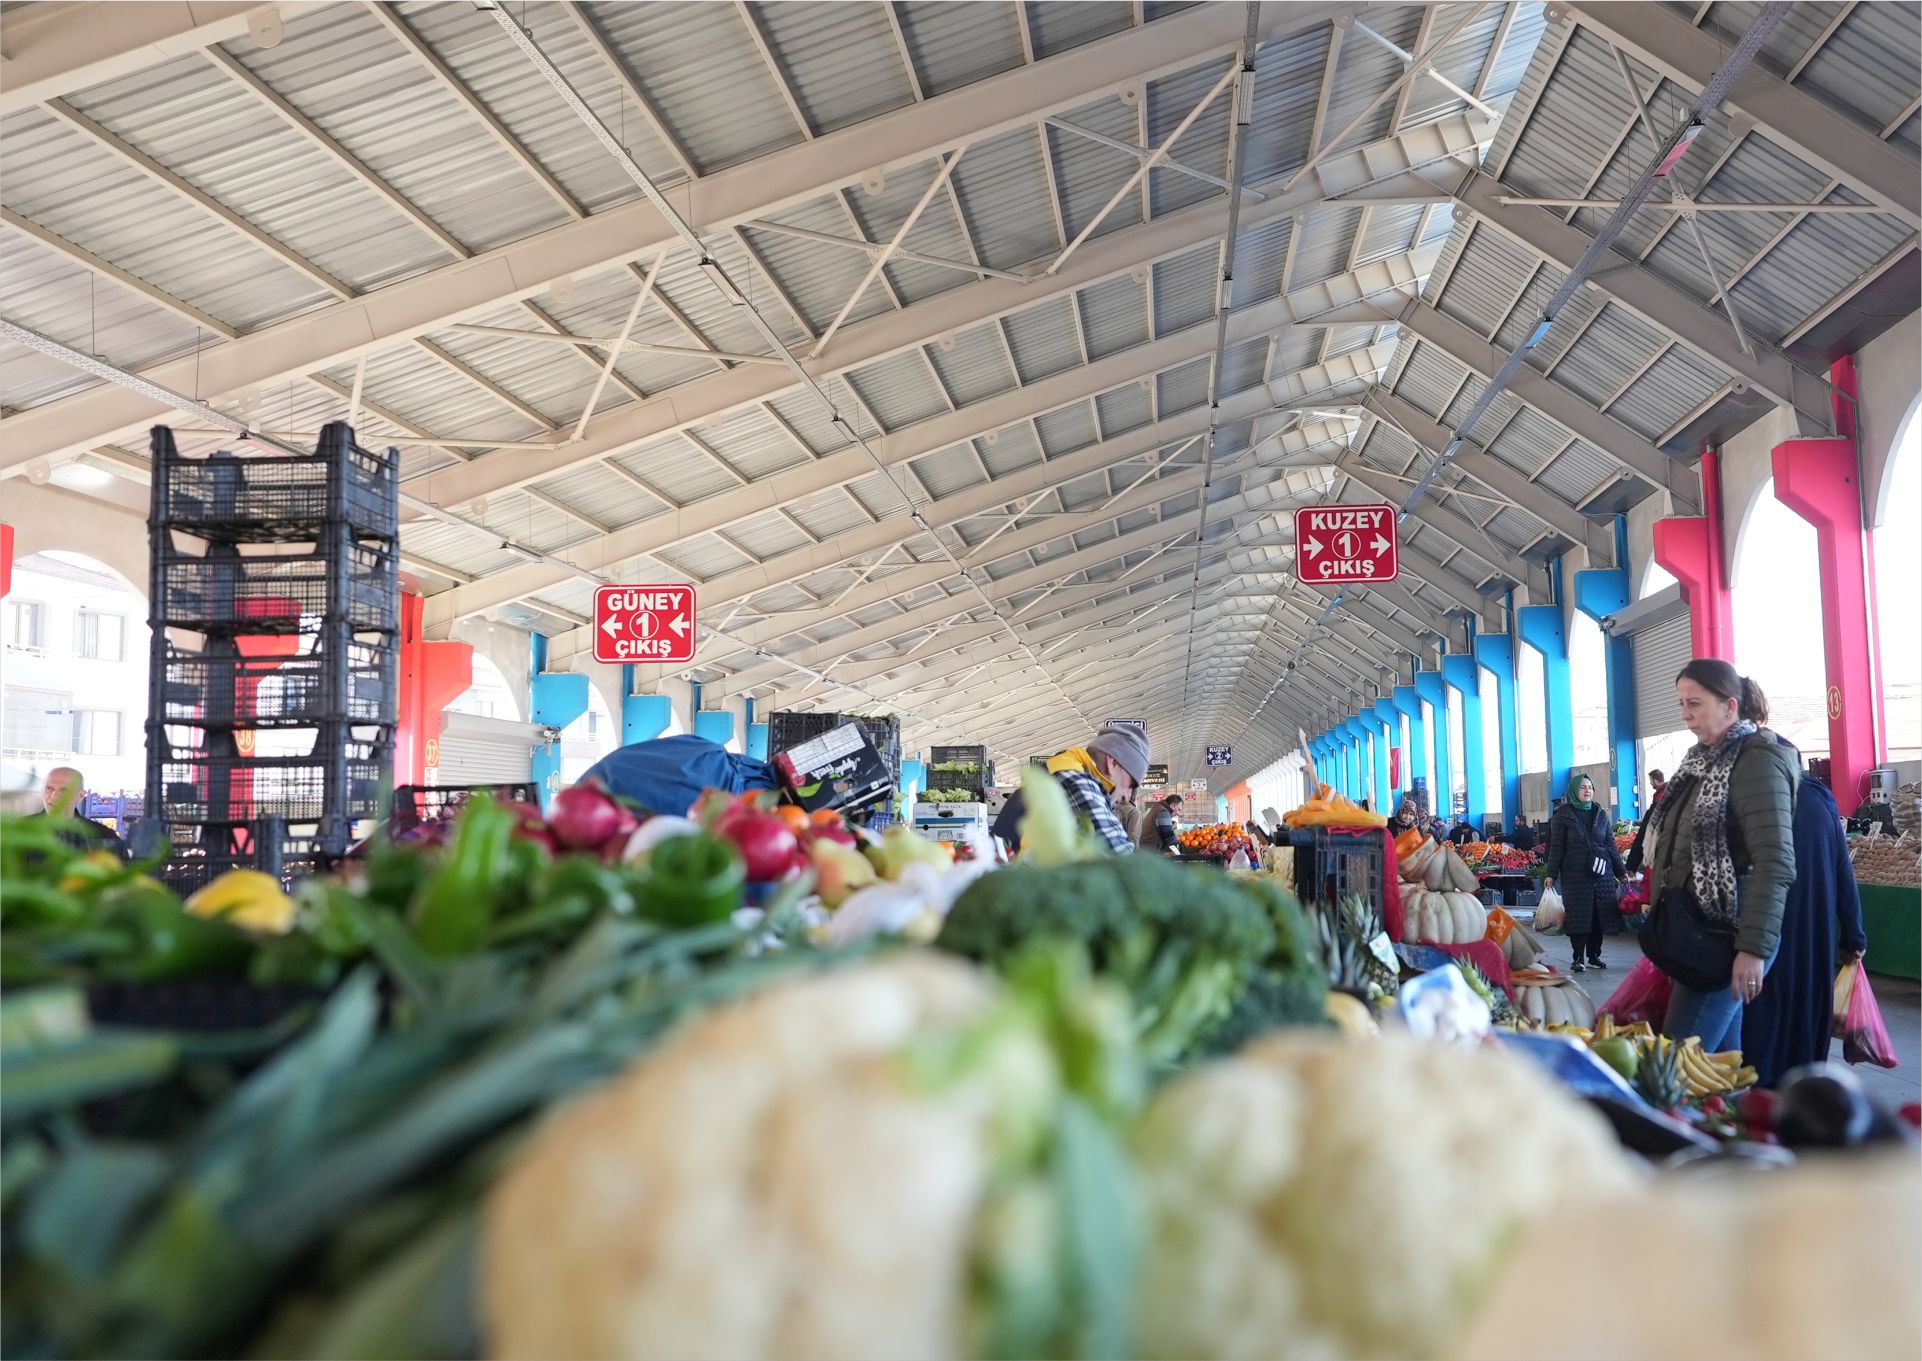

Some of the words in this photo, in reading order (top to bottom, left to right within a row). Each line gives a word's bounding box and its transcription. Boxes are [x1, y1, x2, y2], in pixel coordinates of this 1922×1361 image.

[1311, 511, 1384, 530] KUZEY
[1338, 533, 1352, 557] 1
[1319, 560, 1375, 579] ÇIKIŞ
[607, 589, 683, 611] GÜNEY
[636, 613, 649, 637] 1
[615, 640, 672, 658] ÇIKIŞ
[1829, 691, 1839, 713] 13
[835, 757, 861, 776] Apple
